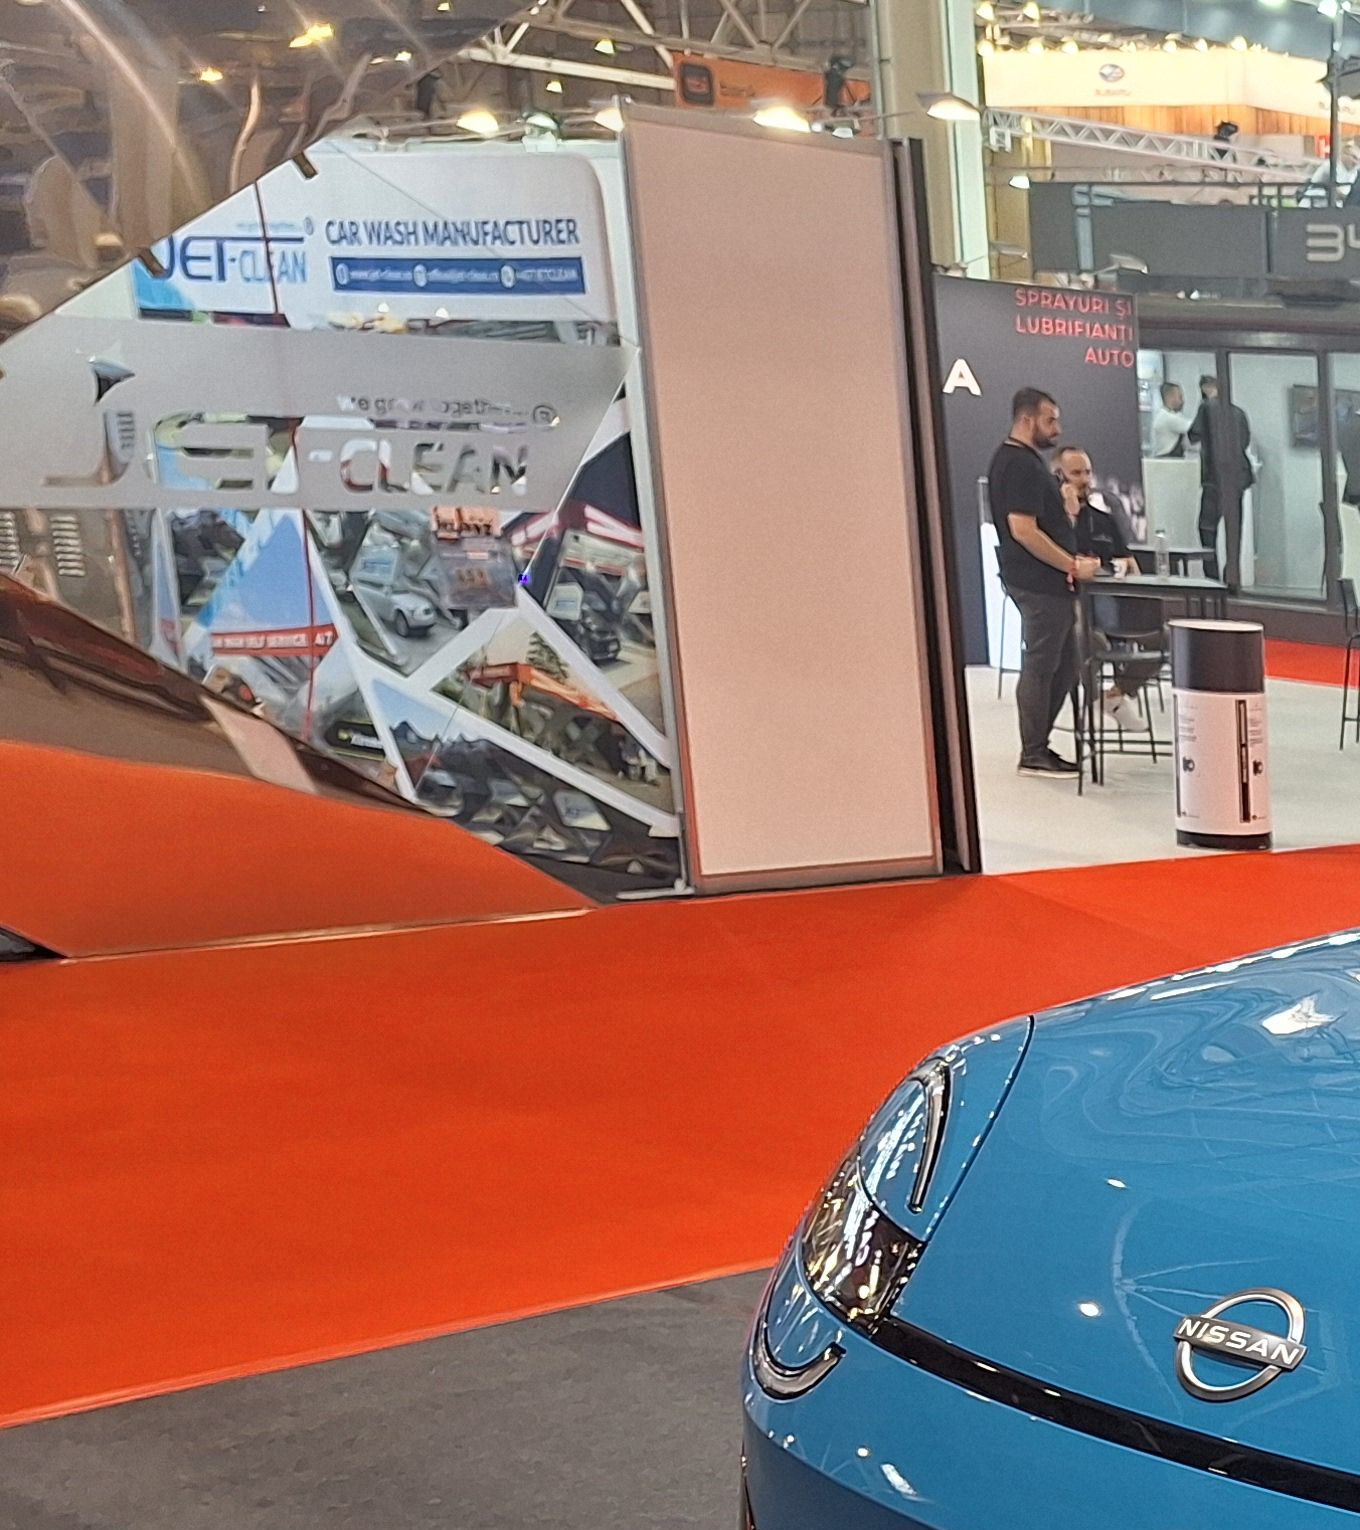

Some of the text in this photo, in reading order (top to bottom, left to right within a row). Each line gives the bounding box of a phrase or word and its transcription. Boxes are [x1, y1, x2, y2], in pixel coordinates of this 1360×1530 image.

[326, 219, 579, 246] CAR WASH MANUFACTURER
[1015, 288, 1109, 314] SPRAYURI
[1085, 346, 1135, 368] AUTO
[1177, 1317, 1301, 1366] NISSAN
